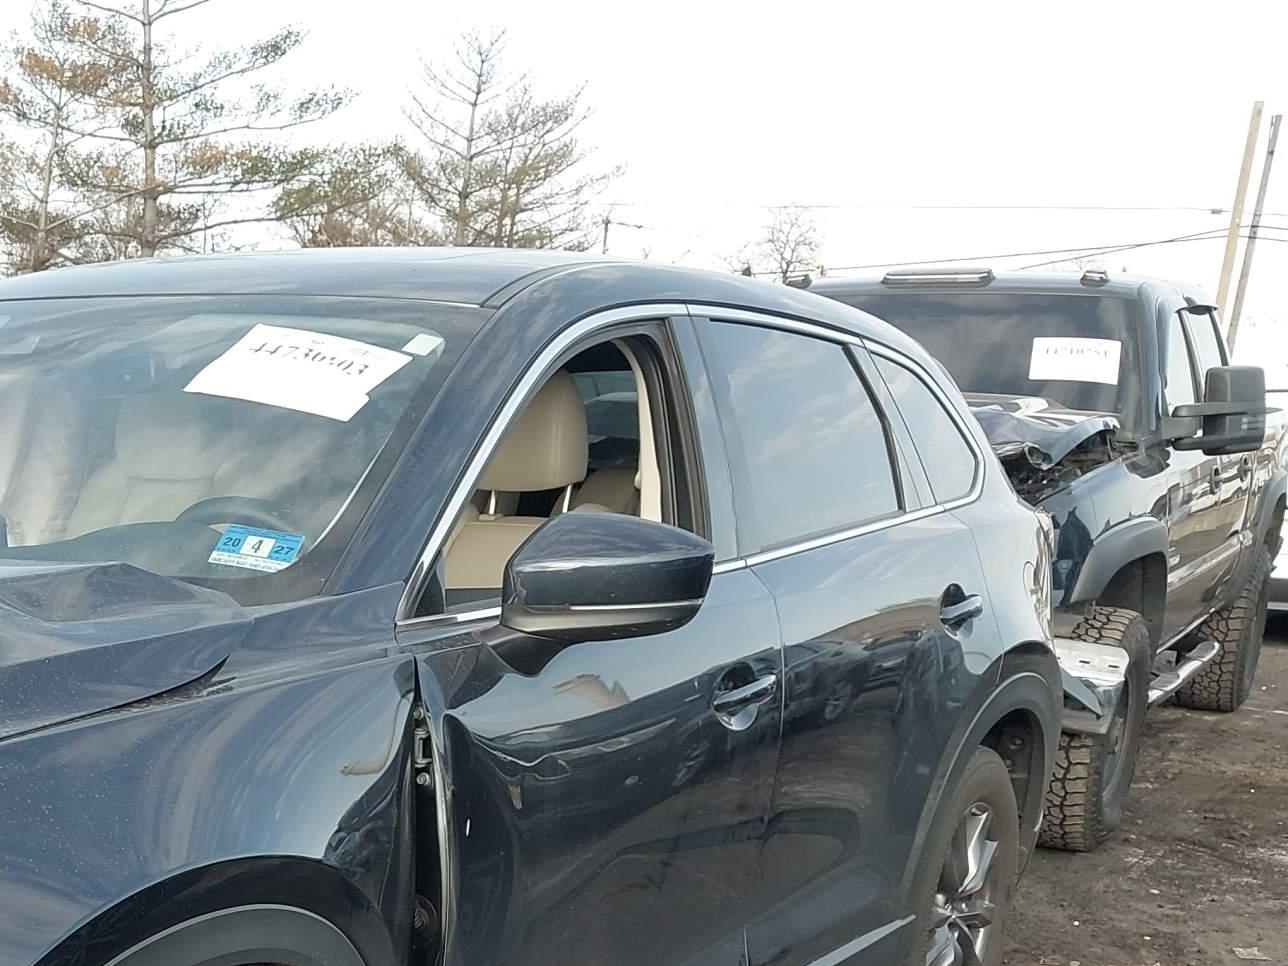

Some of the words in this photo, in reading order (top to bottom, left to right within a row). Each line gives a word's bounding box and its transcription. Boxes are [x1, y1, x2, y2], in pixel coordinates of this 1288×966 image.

[223, 536, 241, 548] 20
[252, 539, 265, 554] 4
[273, 545, 295, 556] 27
